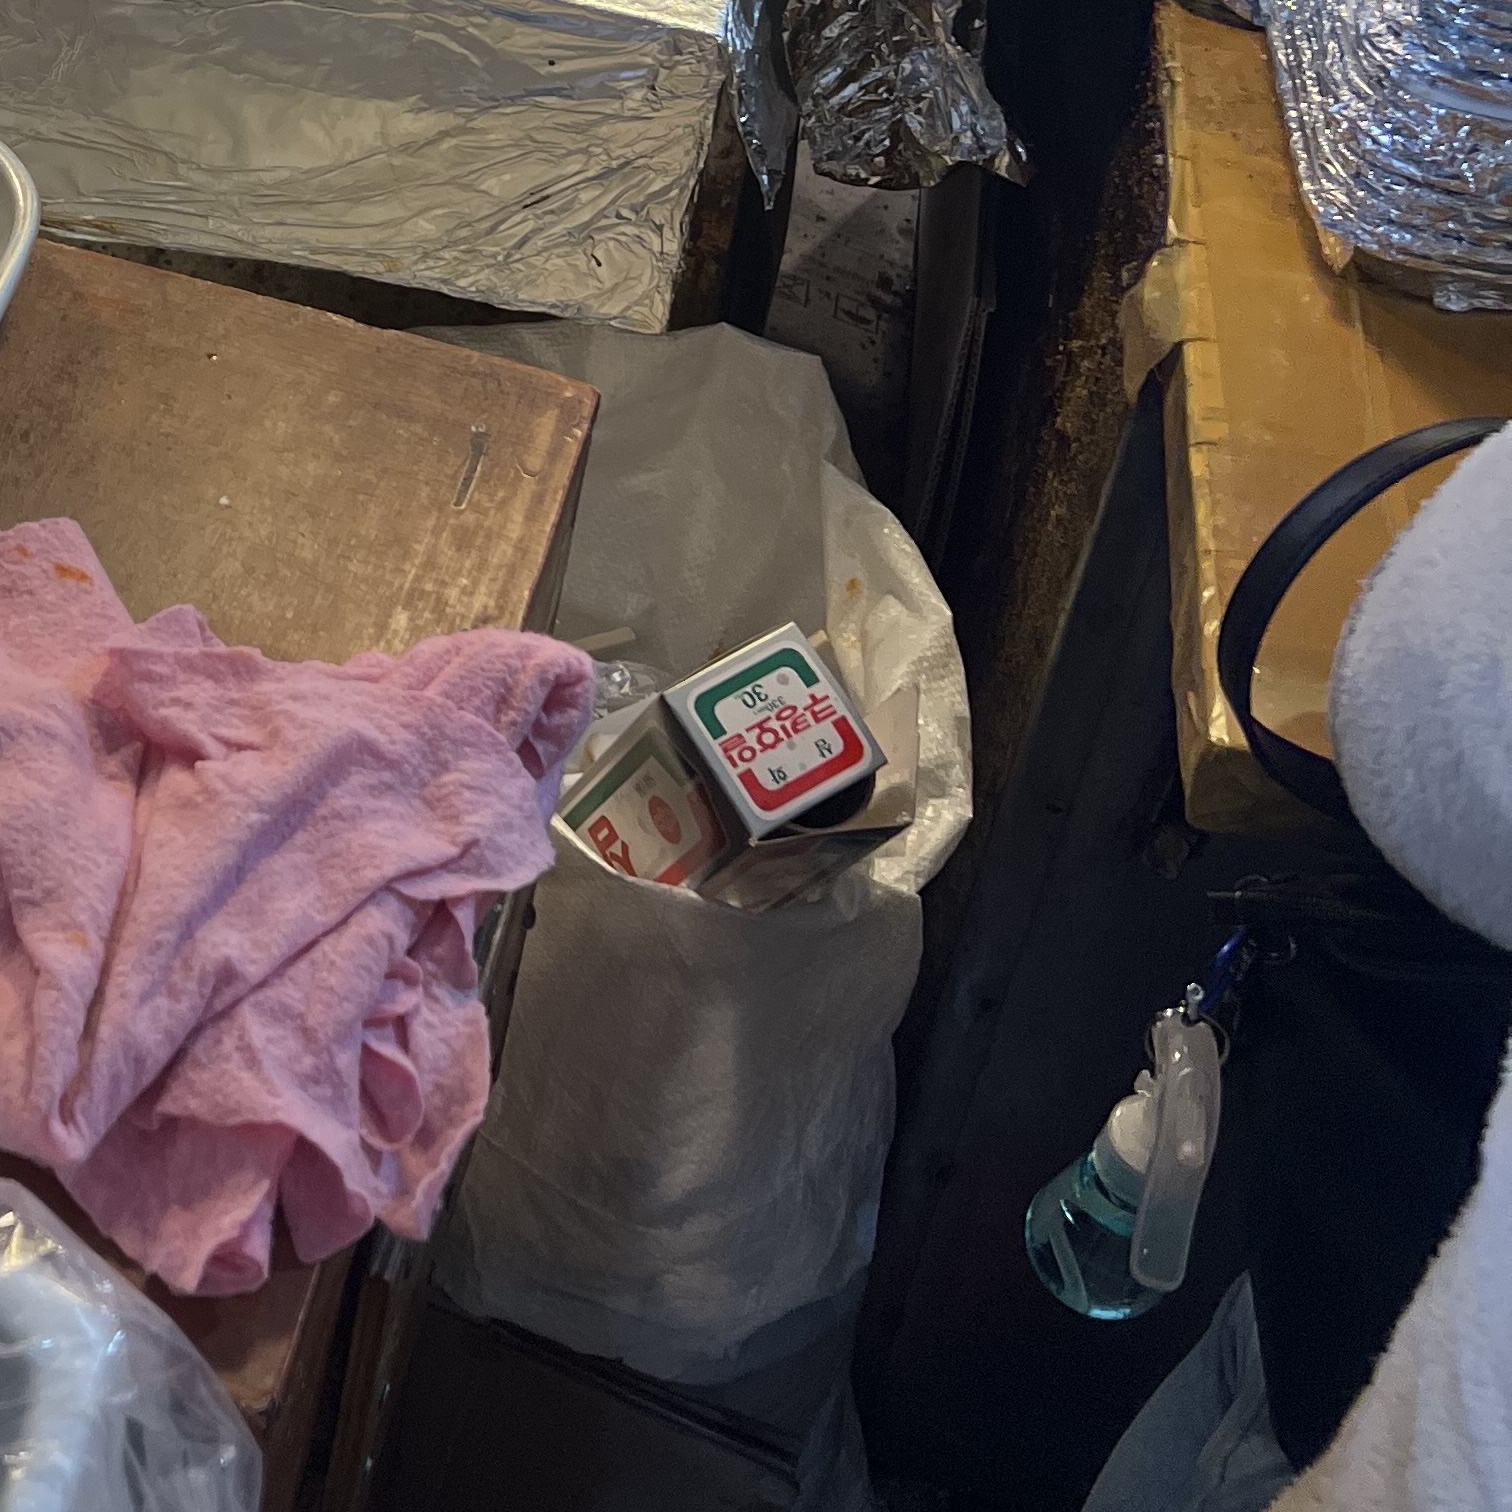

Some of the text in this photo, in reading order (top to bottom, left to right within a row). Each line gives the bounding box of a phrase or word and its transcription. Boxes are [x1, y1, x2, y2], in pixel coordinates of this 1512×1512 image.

[718, 693, 837, 768] 쿠킹호일
[768, 738, 833, 785] 삼 화
